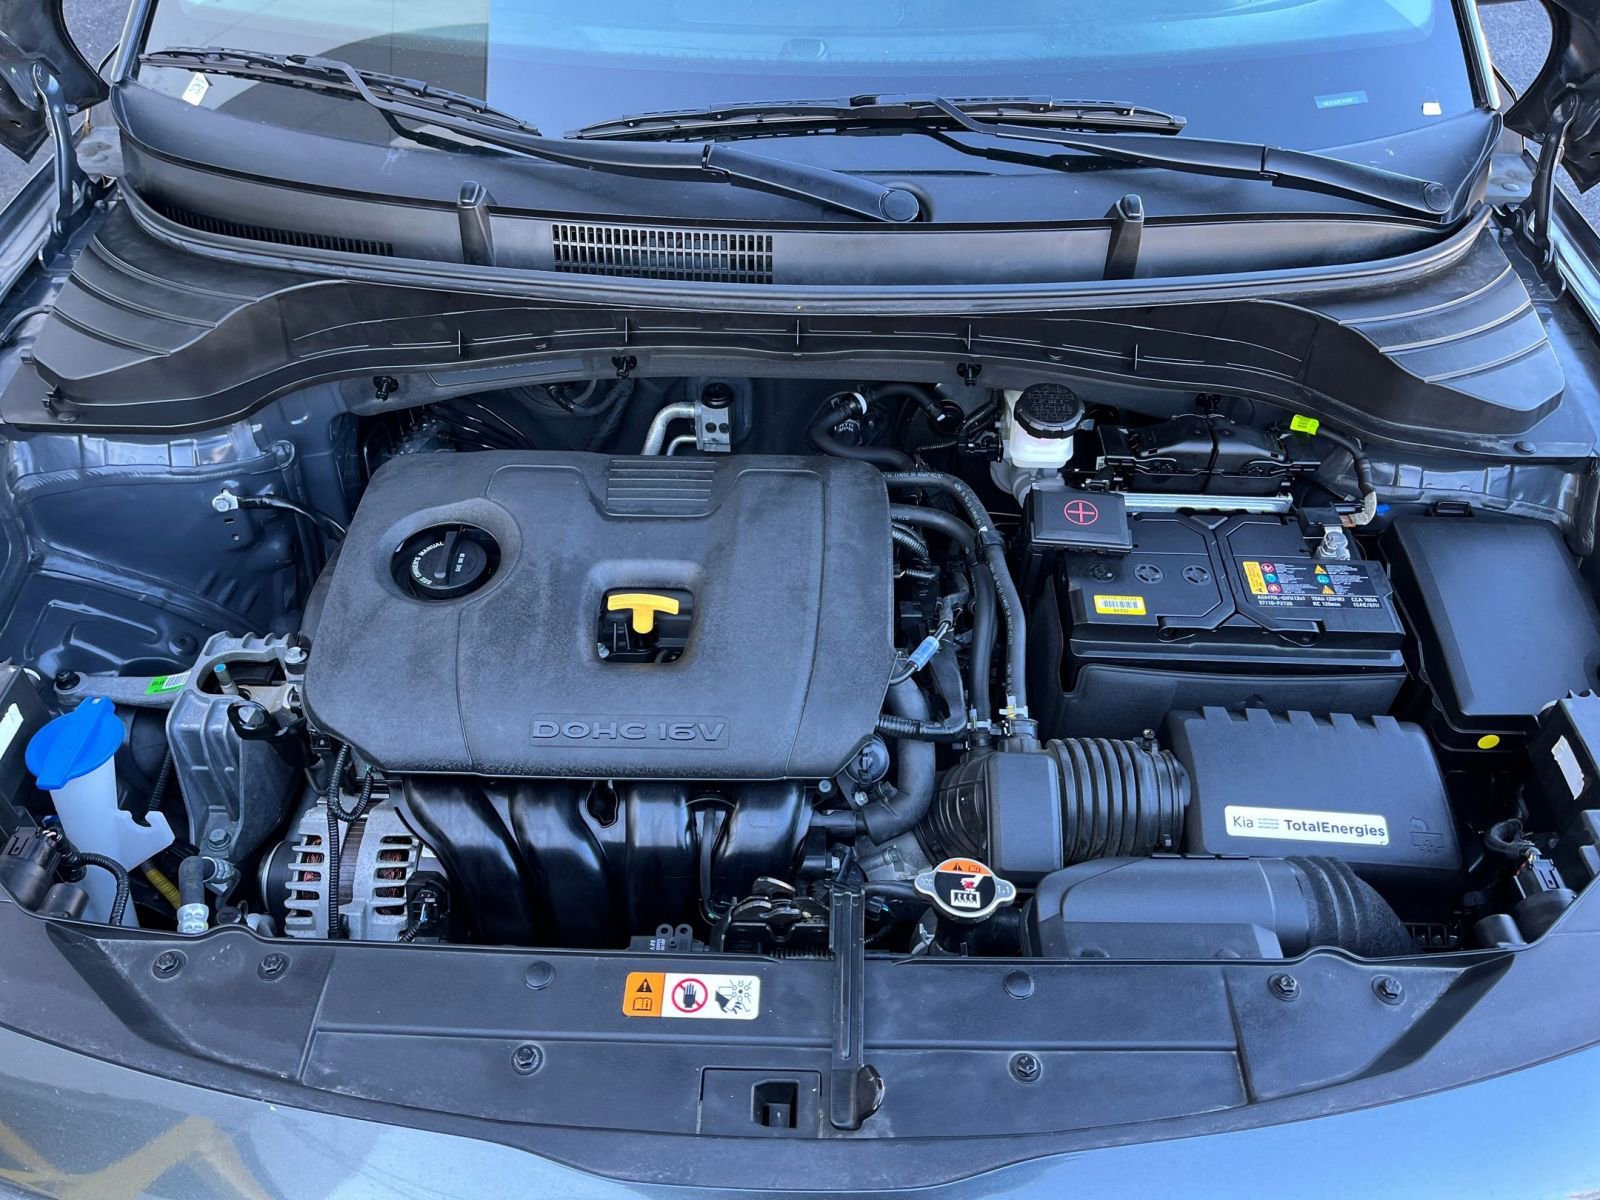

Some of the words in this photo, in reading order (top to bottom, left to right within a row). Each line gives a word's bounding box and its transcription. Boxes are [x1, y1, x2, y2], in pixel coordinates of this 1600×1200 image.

[532, 721, 648, 740] DOHC
[657, 722, 726, 742] 16V
[1232, 815, 1254, 829] Kia
[1283, 819, 1386, 838] TotalEnergies
